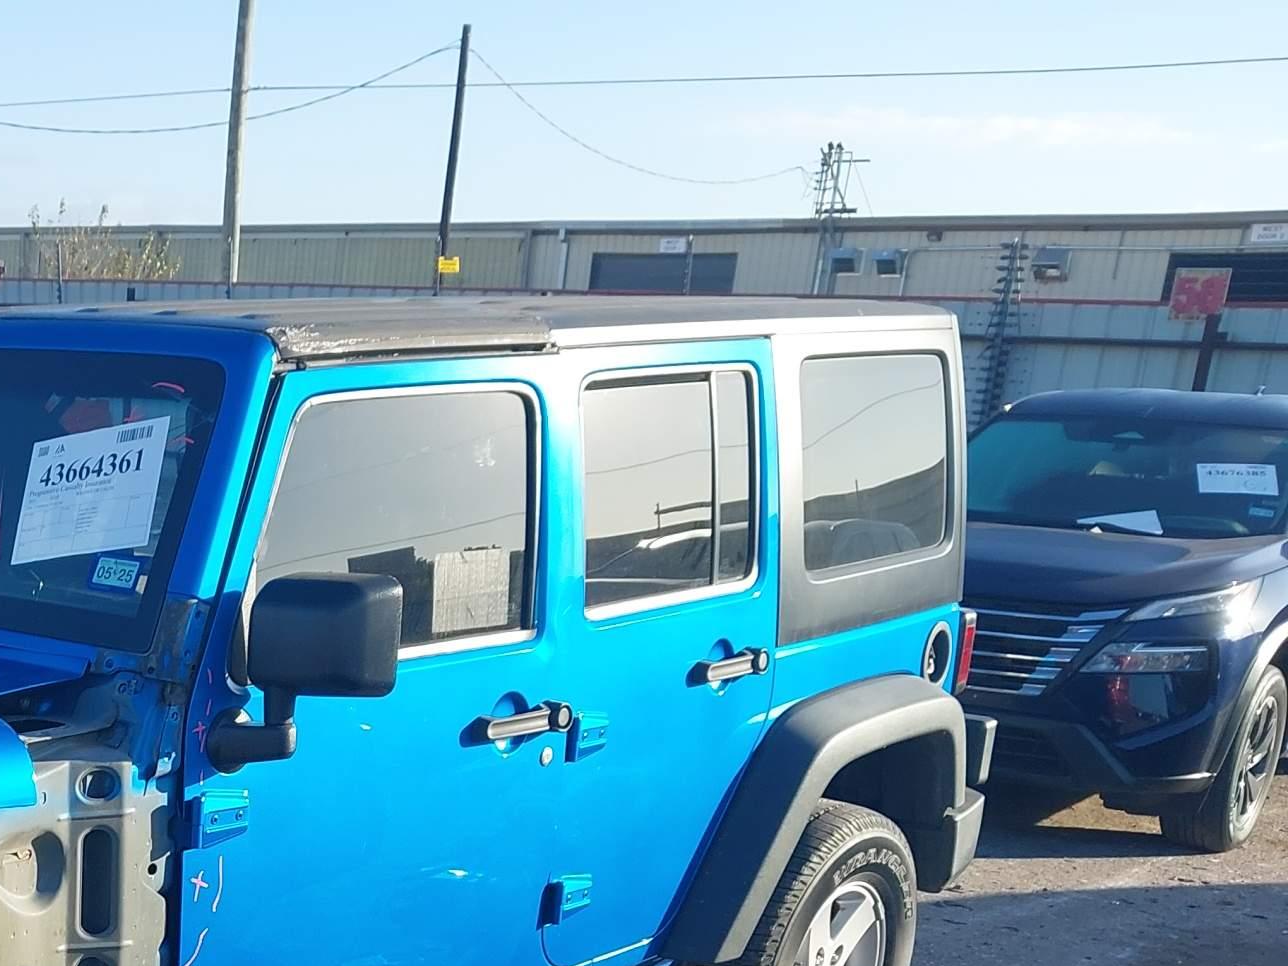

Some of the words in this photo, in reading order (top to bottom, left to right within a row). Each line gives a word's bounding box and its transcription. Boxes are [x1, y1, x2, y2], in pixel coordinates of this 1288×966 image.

[39, 448, 144, 488] 43664361
[96, 566, 113, 580] 05
[117, 568, 135, 583] 25
